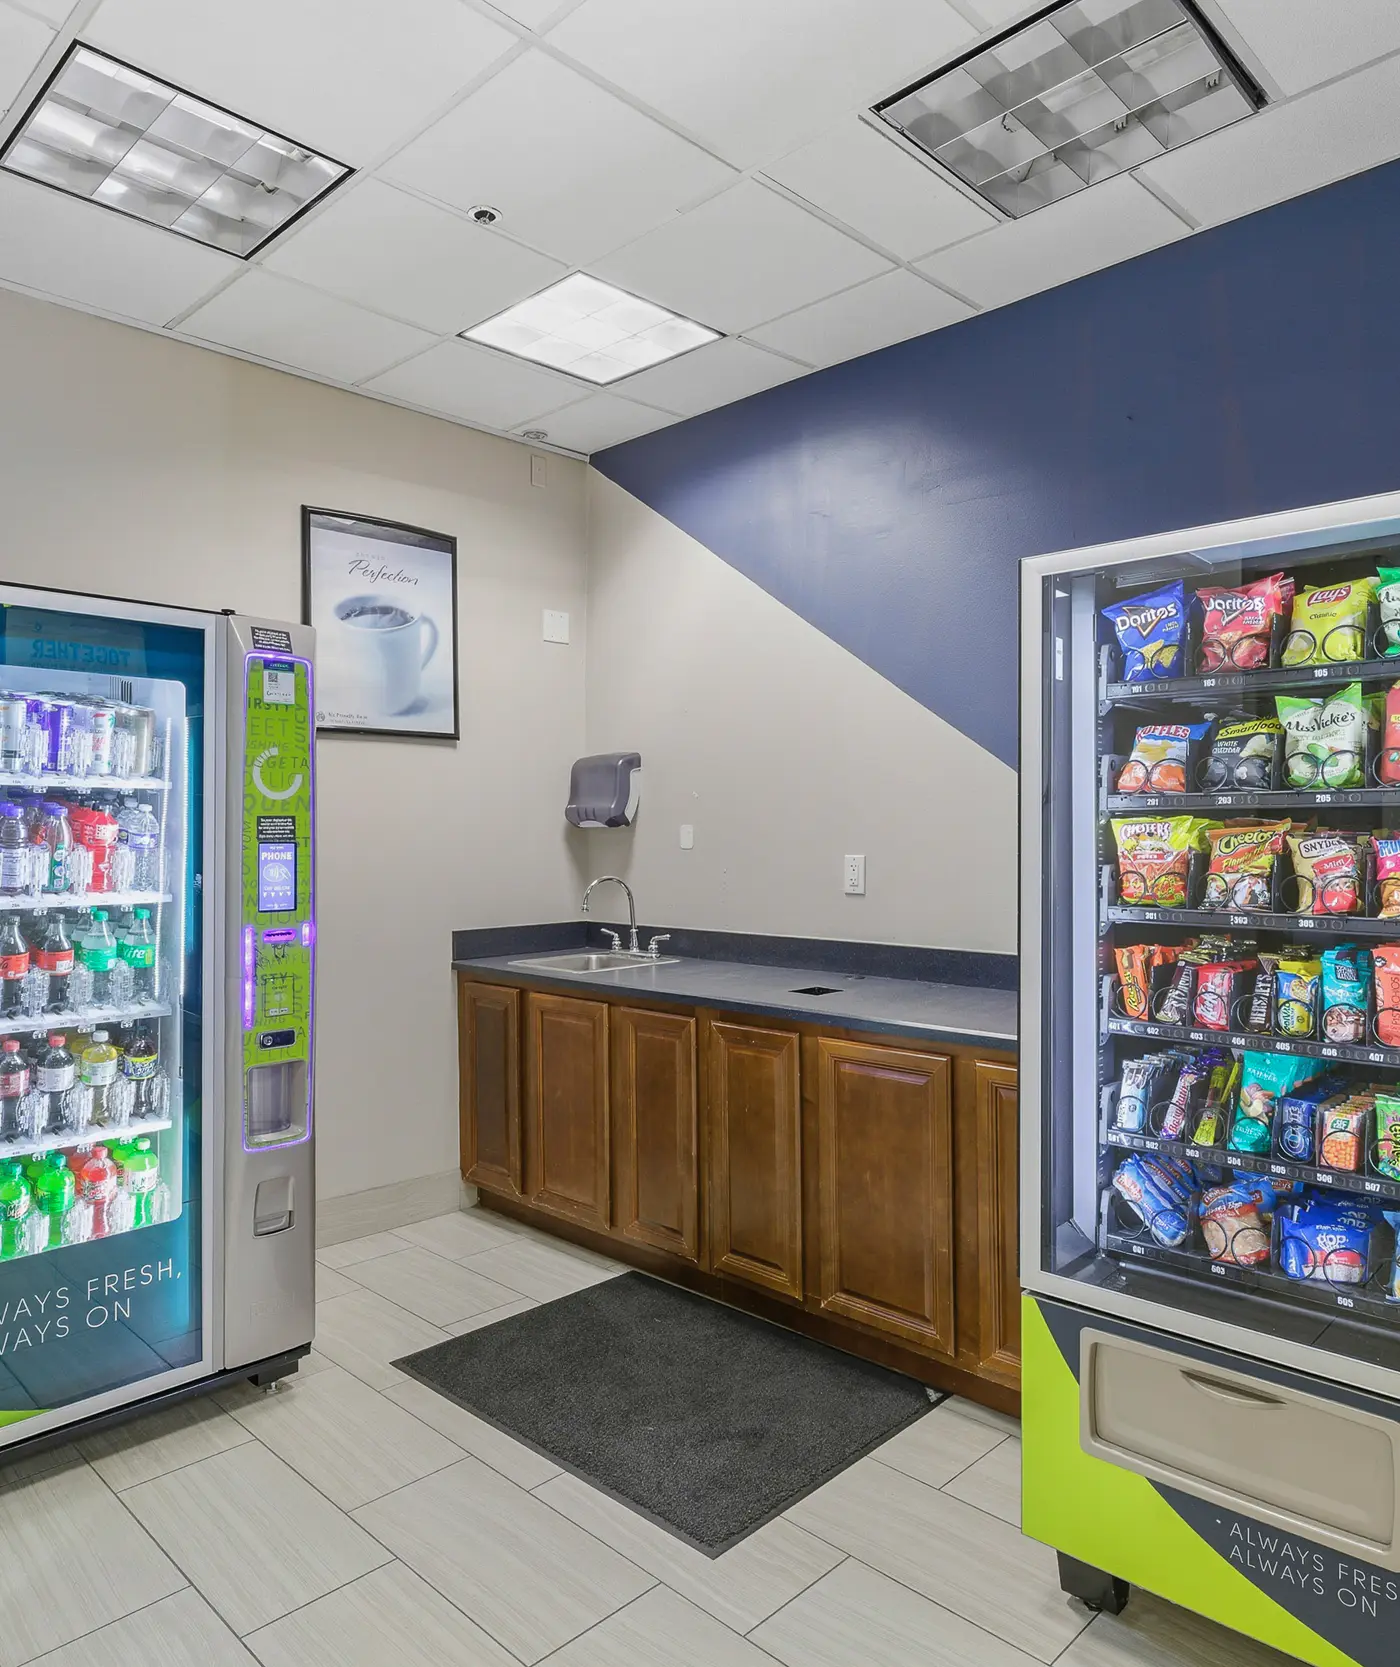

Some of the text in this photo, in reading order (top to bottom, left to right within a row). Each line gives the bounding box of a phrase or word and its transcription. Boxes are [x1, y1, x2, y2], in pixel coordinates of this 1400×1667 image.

[348, 559, 419, 586] Perfection
[1116, 603, 1177, 631] Doritos
[1313, 668, 1328, 677] 105
[1285, 712, 1356, 733] Miss Vickie's
[1136, 724, 1191, 742] RUFFLES
[1146, 798, 1159, 806] 201
[1217, 796, 1232, 805] 203
[1315, 794, 1331, 803] 205
[1219, 831, 1275, 854] Cheetos
[261, 851, 293, 861] PHONE
[1298, 919, 1314, 928] 305
[1189, 1032, 1203, 1040] 403
[1275, 1042, 1290, 1051] 405
[1321, 1048, 1338, 1057] 406
[1368, 1052, 1384, 1062] 407
[1145, 1141, 1159, 1150] 502
[1185, 1148, 1200, 1158] 503
[1227, 1156, 1241, 1166] 504
[1364, 1181, 1381, 1193] 507
[87, 1258, 183, 1301] FRESH,
[1337, 1296, 1354, 1308] 605
[0, 1297, 131, 1356] AYS ON
[1229, 1522, 1398, 1601] ALWAYS FRES
[1229, 1544, 1377, 1618] ALWAYS ON
